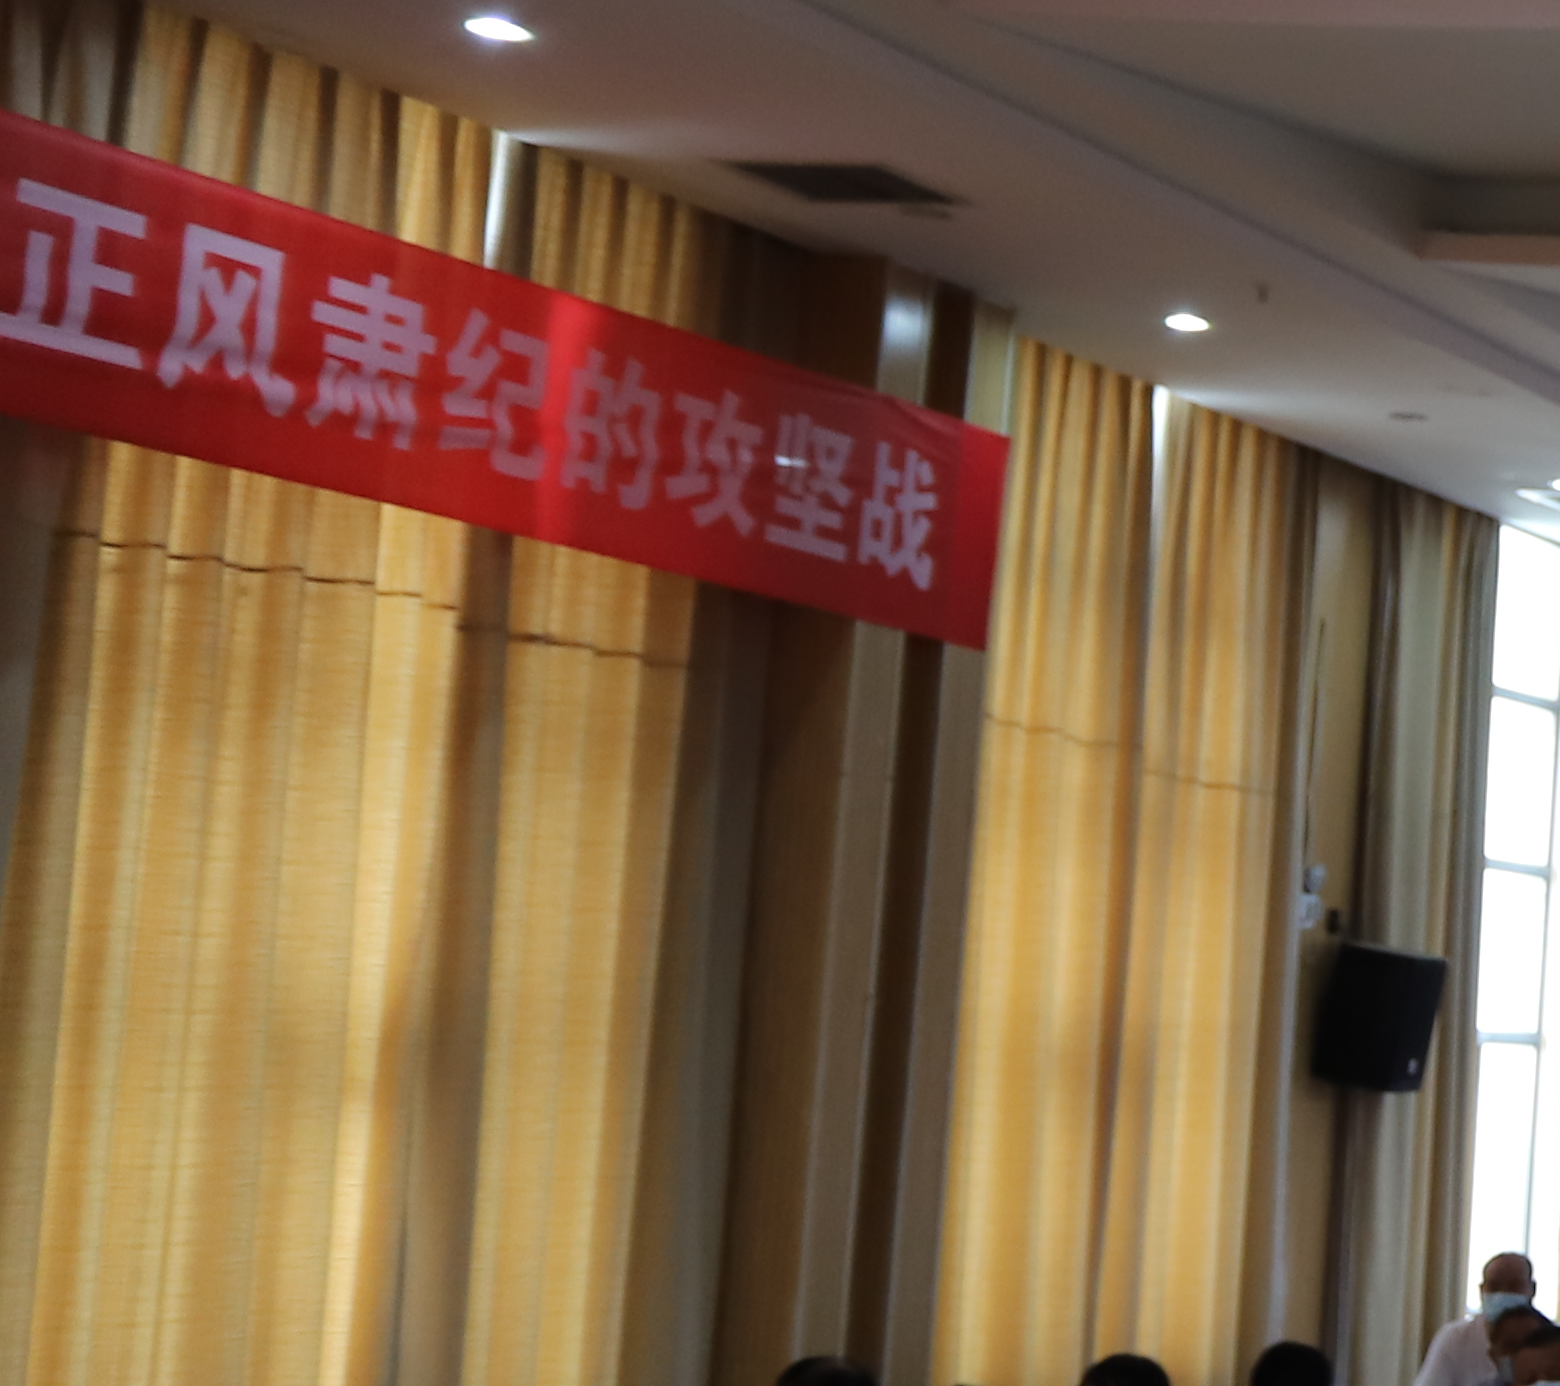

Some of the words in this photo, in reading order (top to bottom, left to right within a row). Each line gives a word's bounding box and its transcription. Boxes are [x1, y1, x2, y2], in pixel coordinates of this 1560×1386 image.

[0, 178, 938, 591] 正风肃纪的攻坚战
